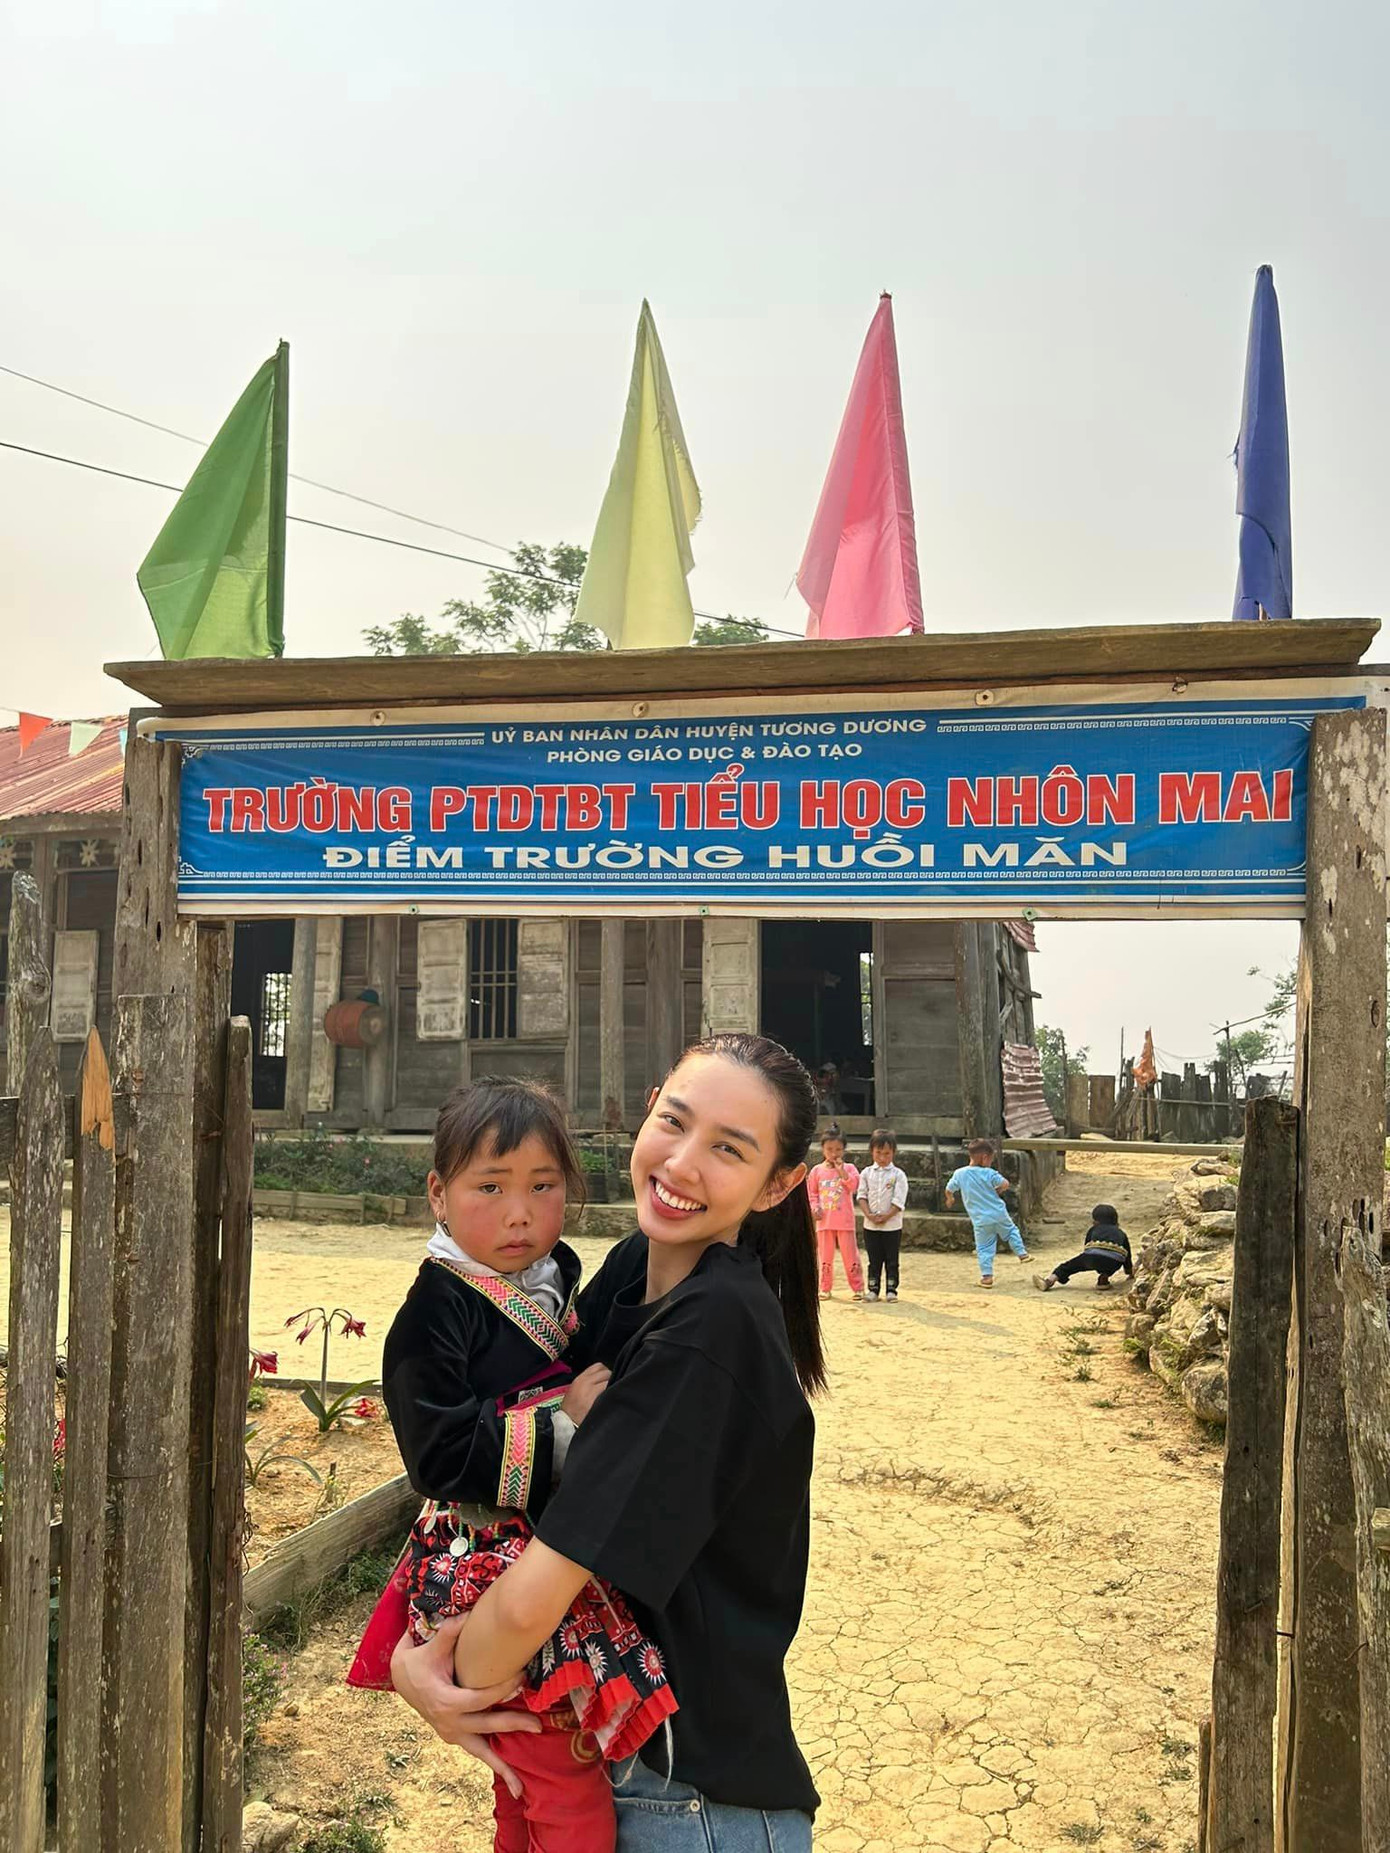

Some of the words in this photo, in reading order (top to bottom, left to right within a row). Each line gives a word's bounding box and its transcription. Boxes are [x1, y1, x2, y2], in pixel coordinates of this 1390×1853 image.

[491, 726, 516, 743] UỶ
[523, 729, 563, 742] BAN
[570, 726, 628, 741] NHÂN
[635, 725, 679, 740] DÂN
[686, 722, 754, 741] HUYỆN
[760, 721, 836, 736] TƯƠNG
[843, 718, 927, 735] DƯƠNG
[547, 747, 621, 763] PHÒNG
[627, 745, 682, 761] GIÁO
[688, 747, 734, 764] DỤC
[741, 747, 755, 760] &
[763, 741, 812, 759] ĐÀO
[818, 743, 863, 760] TẠO
[203, 777, 413, 833] TRƯỜNG
[430, 783, 636, 832] PTDTBT
[651, 762, 780, 831] TIỂU
[800, 778, 926, 839] HỌC
[947, 764, 1136, 828] NHÔN
[1158, 768, 1294, 825] MAI
[322, 834, 464, 869] ĐIỂM
[484, 839, 745, 869] TRƯỜNG
[768, 831, 935, 868] HUỒI
[963, 836, 1127, 867] MĂN
